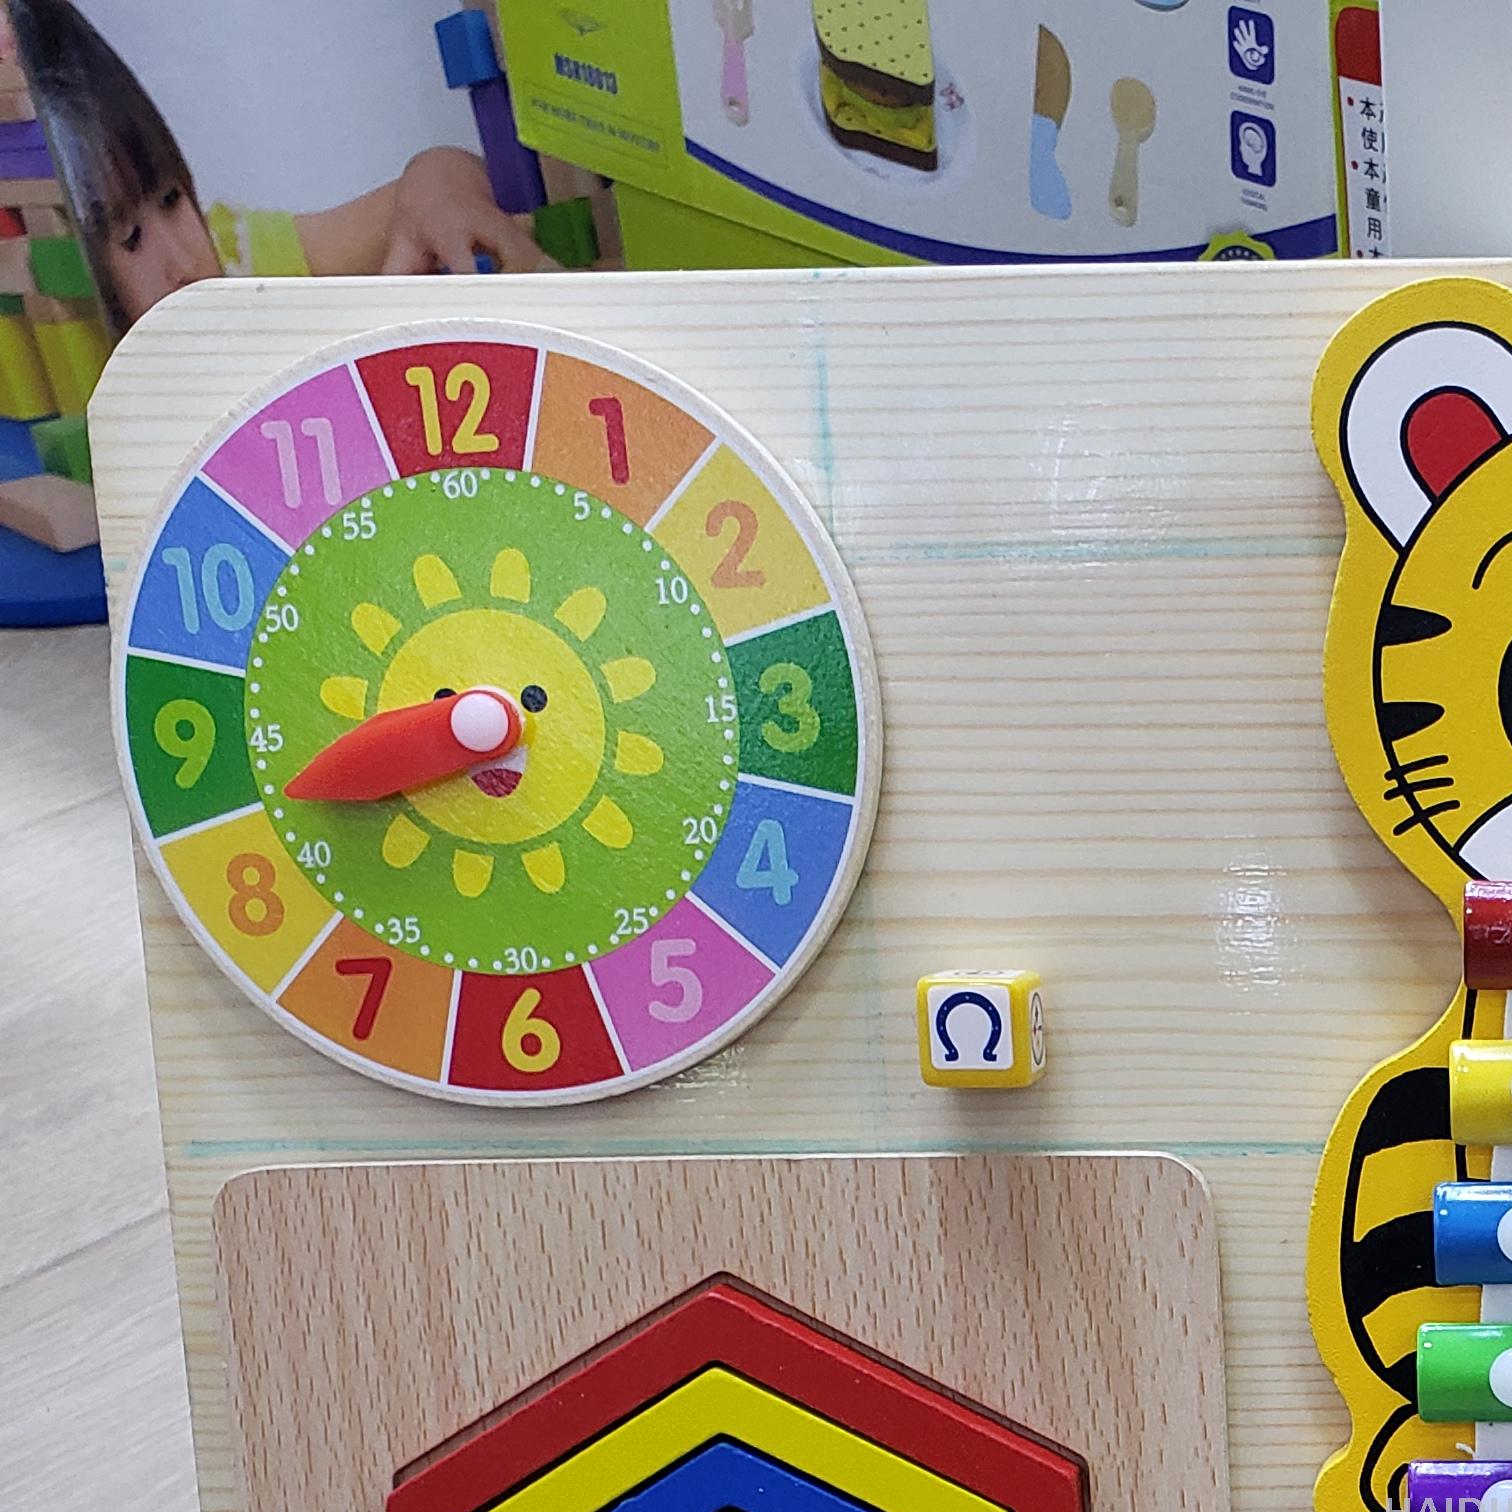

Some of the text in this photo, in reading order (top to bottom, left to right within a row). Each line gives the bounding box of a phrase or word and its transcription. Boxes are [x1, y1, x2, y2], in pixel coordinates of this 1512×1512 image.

[405, 362, 499, 456] 12
[260, 417, 343, 509] 11
[588, 396, 630, 486] 1
[443, 473, 479, 500] 60
[573, 493, 591, 521] 5
[342, 511, 378, 541] 55
[705, 500, 766, 589] 2
[161, 543, 255, 634] 10
[655, 576, 689, 605] 10
[265, 604, 299, 633] 50
[704, 694, 738, 723] 15
[759, 662, 820, 753] 3
[154, 699, 216, 789] 9
[249, 724, 284, 753] 45
[297, 841, 332, 869] 40
[682, 816, 718, 845] 20
[735, 818, 799, 905] 4
[226, 853, 285, 937] 8
[613, 908, 649, 936] 25
[386, 917, 421, 944] 35
[503, 947, 538, 974] 30
[649, 938, 703, 1024] 5
[335, 956, 393, 1041] 7
[502, 987, 561, 1074] 6
